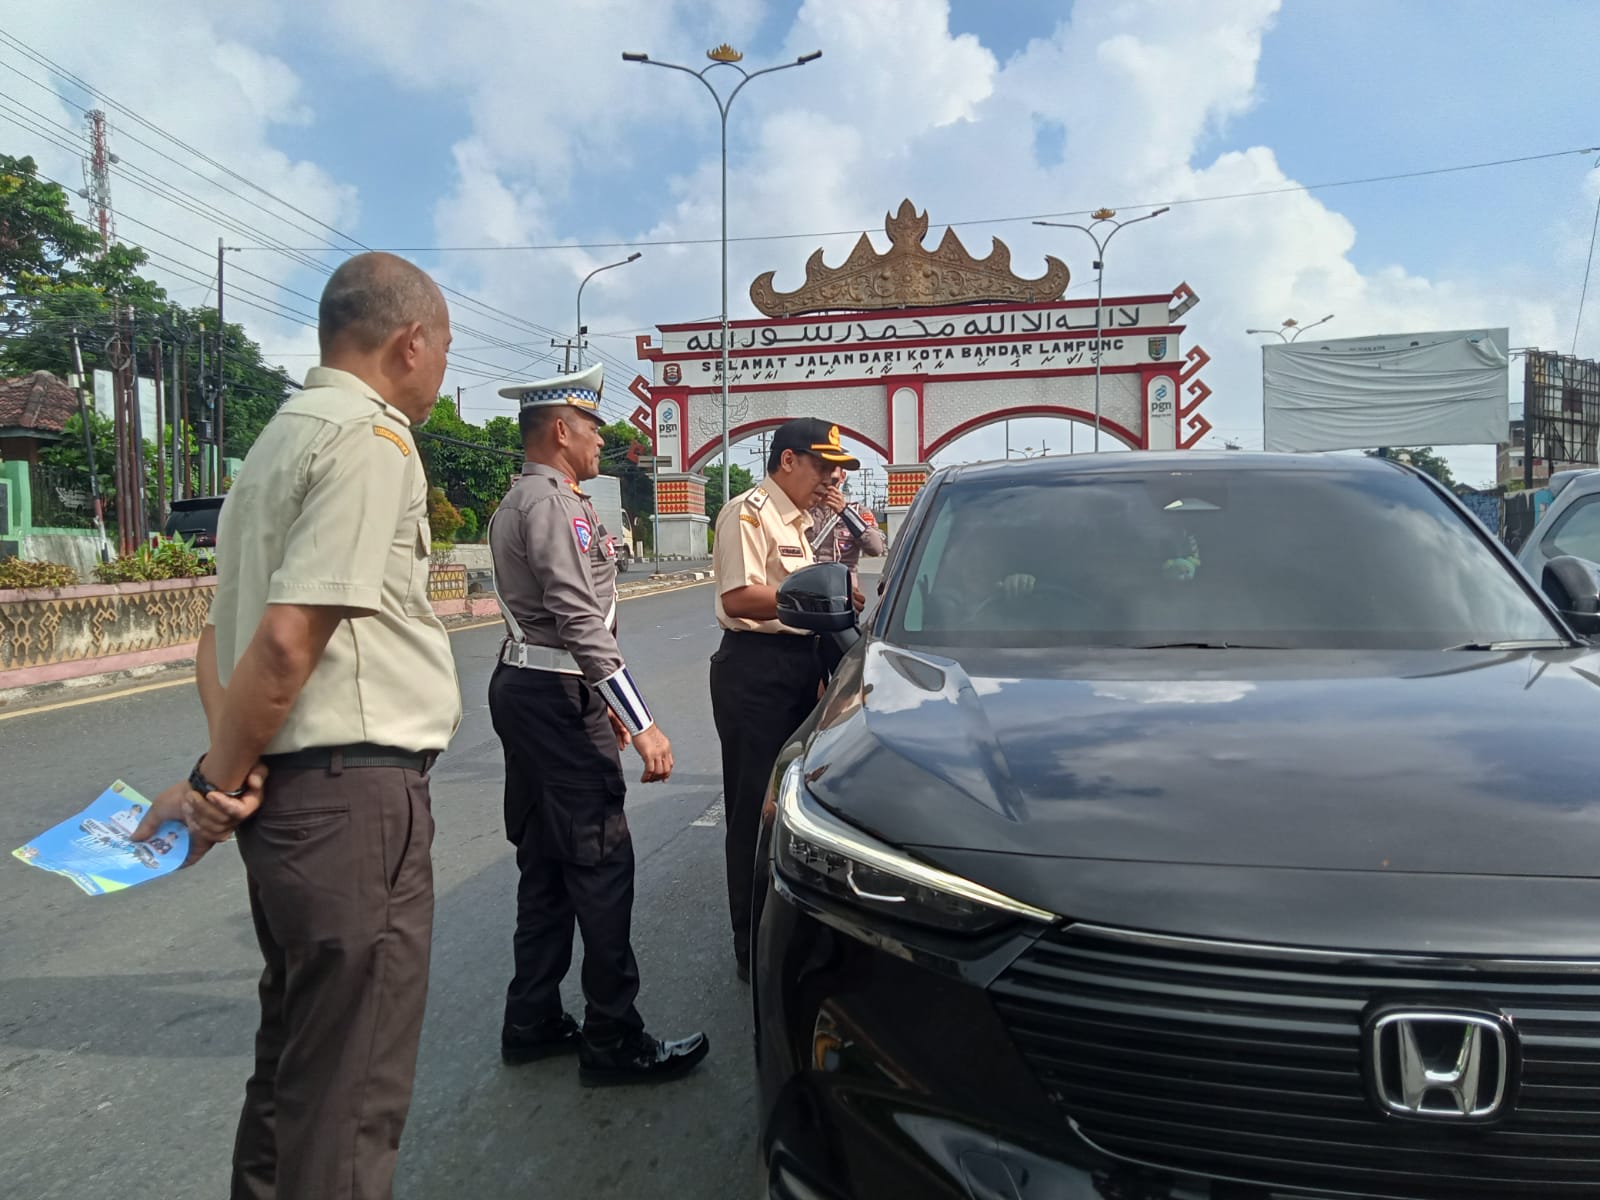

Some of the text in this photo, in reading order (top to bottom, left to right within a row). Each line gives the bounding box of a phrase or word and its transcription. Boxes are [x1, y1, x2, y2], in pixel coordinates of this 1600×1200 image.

[963, 314, 1016, 335] الله
[1118, 307, 1140, 327] لا
[740, 324, 852, 348] رسول
[856, 320, 955, 341] محمد
[687, 331, 735, 351] الله
[702, 357, 787, 372] SELAMAT
[795, 353, 854, 367] JALAN
[859, 350, 902, 365] DARI
[908, 347, 955, 361] KOTA
[962, 343, 1033, 358] BANDAR
[1151, 402, 1172, 412] pgn
[659, 423, 678, 433] pgn
